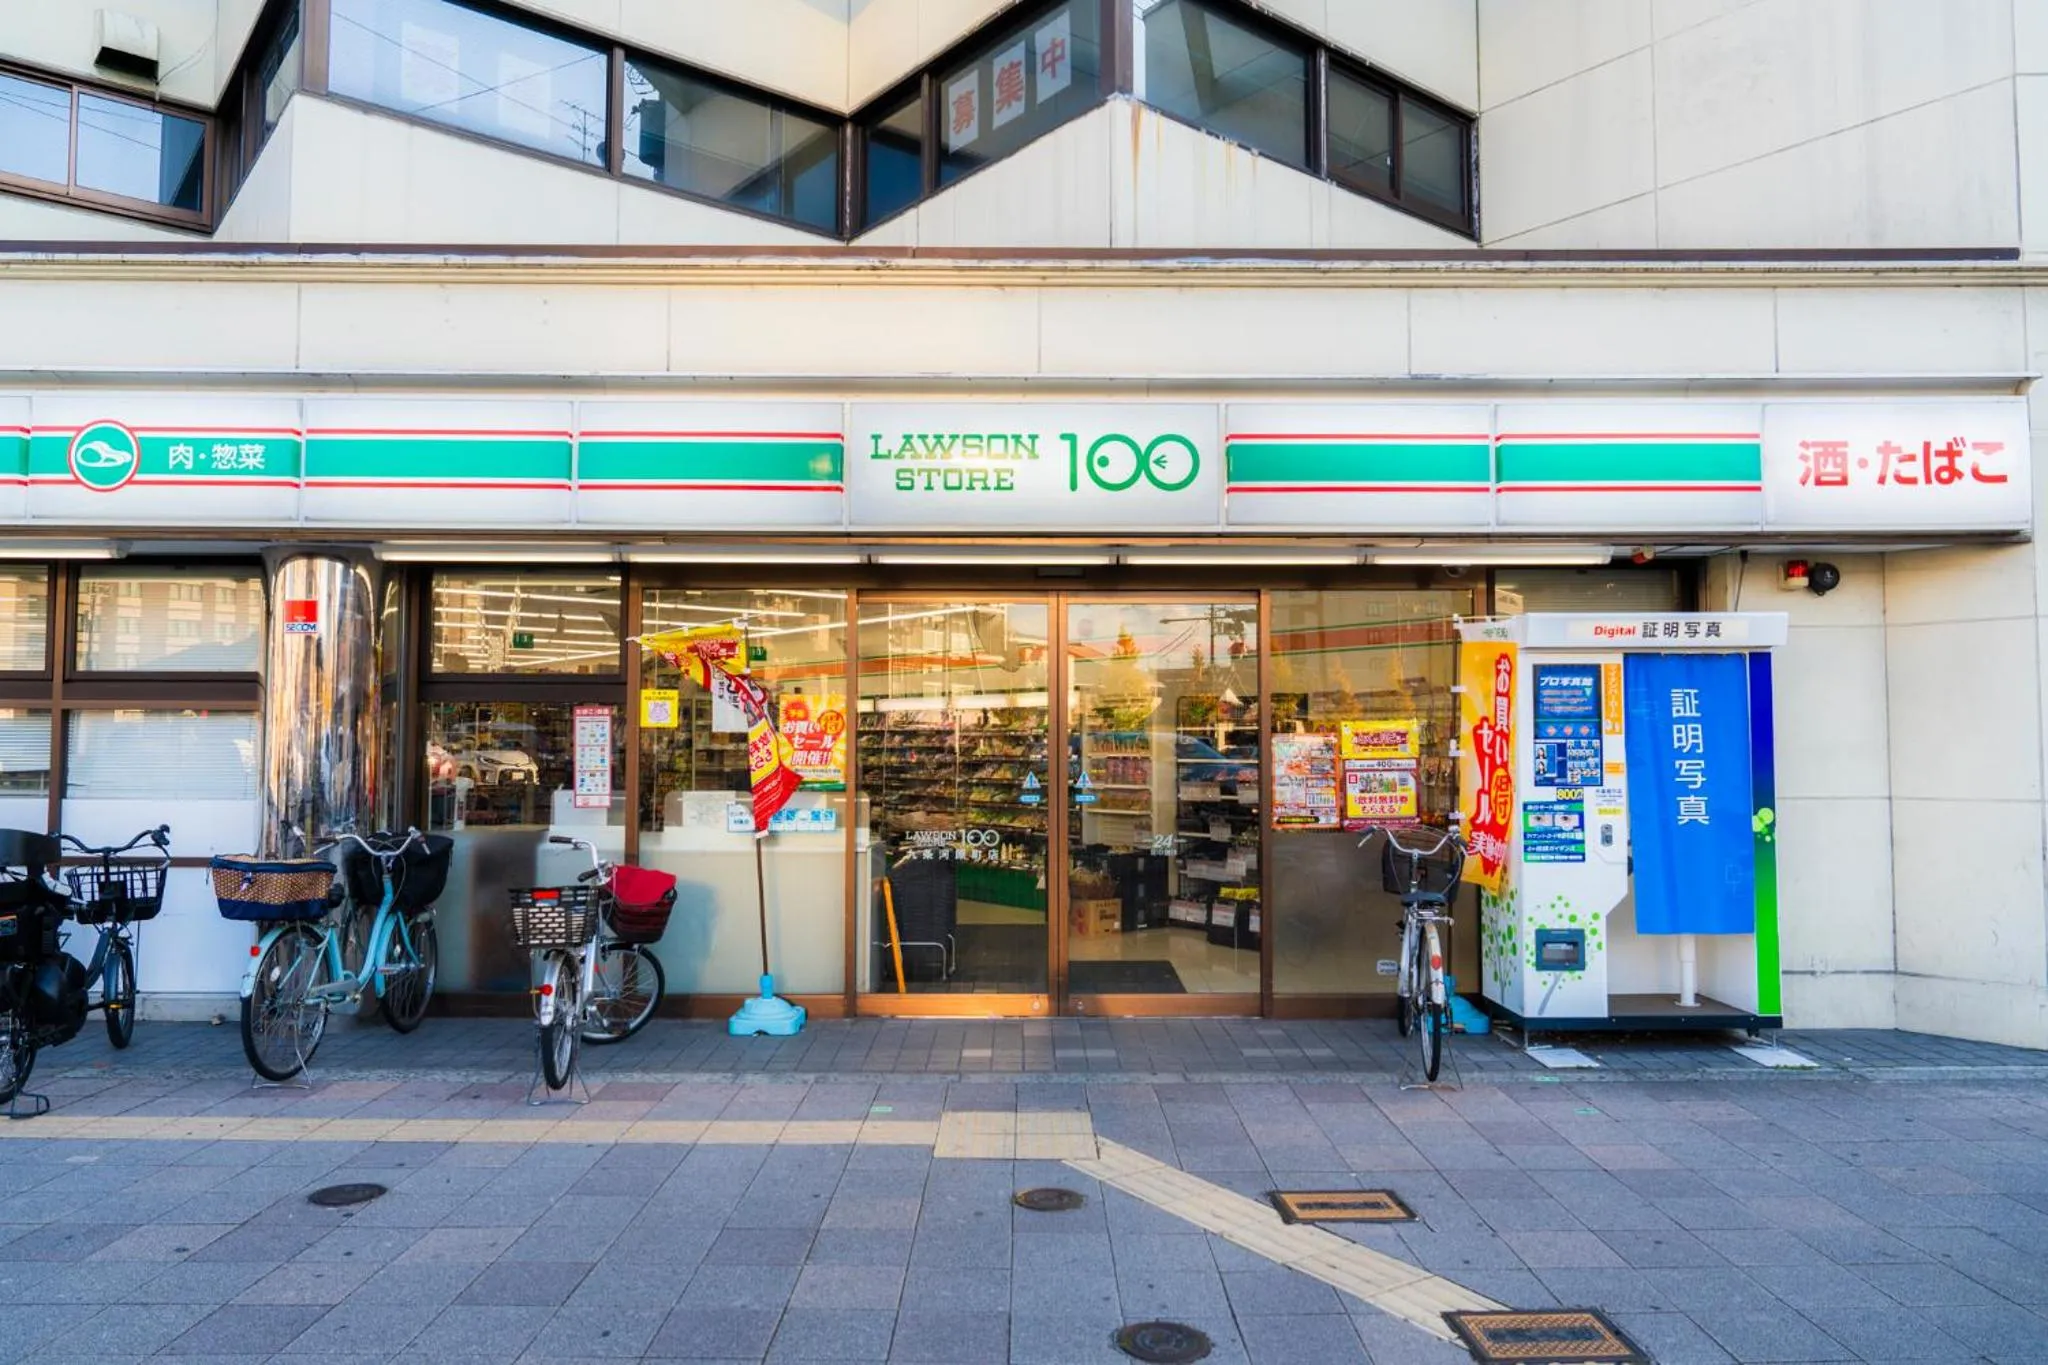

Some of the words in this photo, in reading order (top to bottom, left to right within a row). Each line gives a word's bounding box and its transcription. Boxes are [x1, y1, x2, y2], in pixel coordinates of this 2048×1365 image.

[951, 37, 1066, 134] 募集中
[168, 443, 266, 470] 肉・惣菜
[870, 433, 1039, 460] LAWSON
[1060, 433, 1200, 492] 100
[1798, 436, 2009, 487] 酒・たばこ
[895, 468, 1014, 491] STORE
[1594, 624, 1636, 638] Digital
[1642, 621, 1722, 638] 証明写真
[1670, 688, 1710, 825] 証明写真
[905, 830, 957, 840] LAWSON
